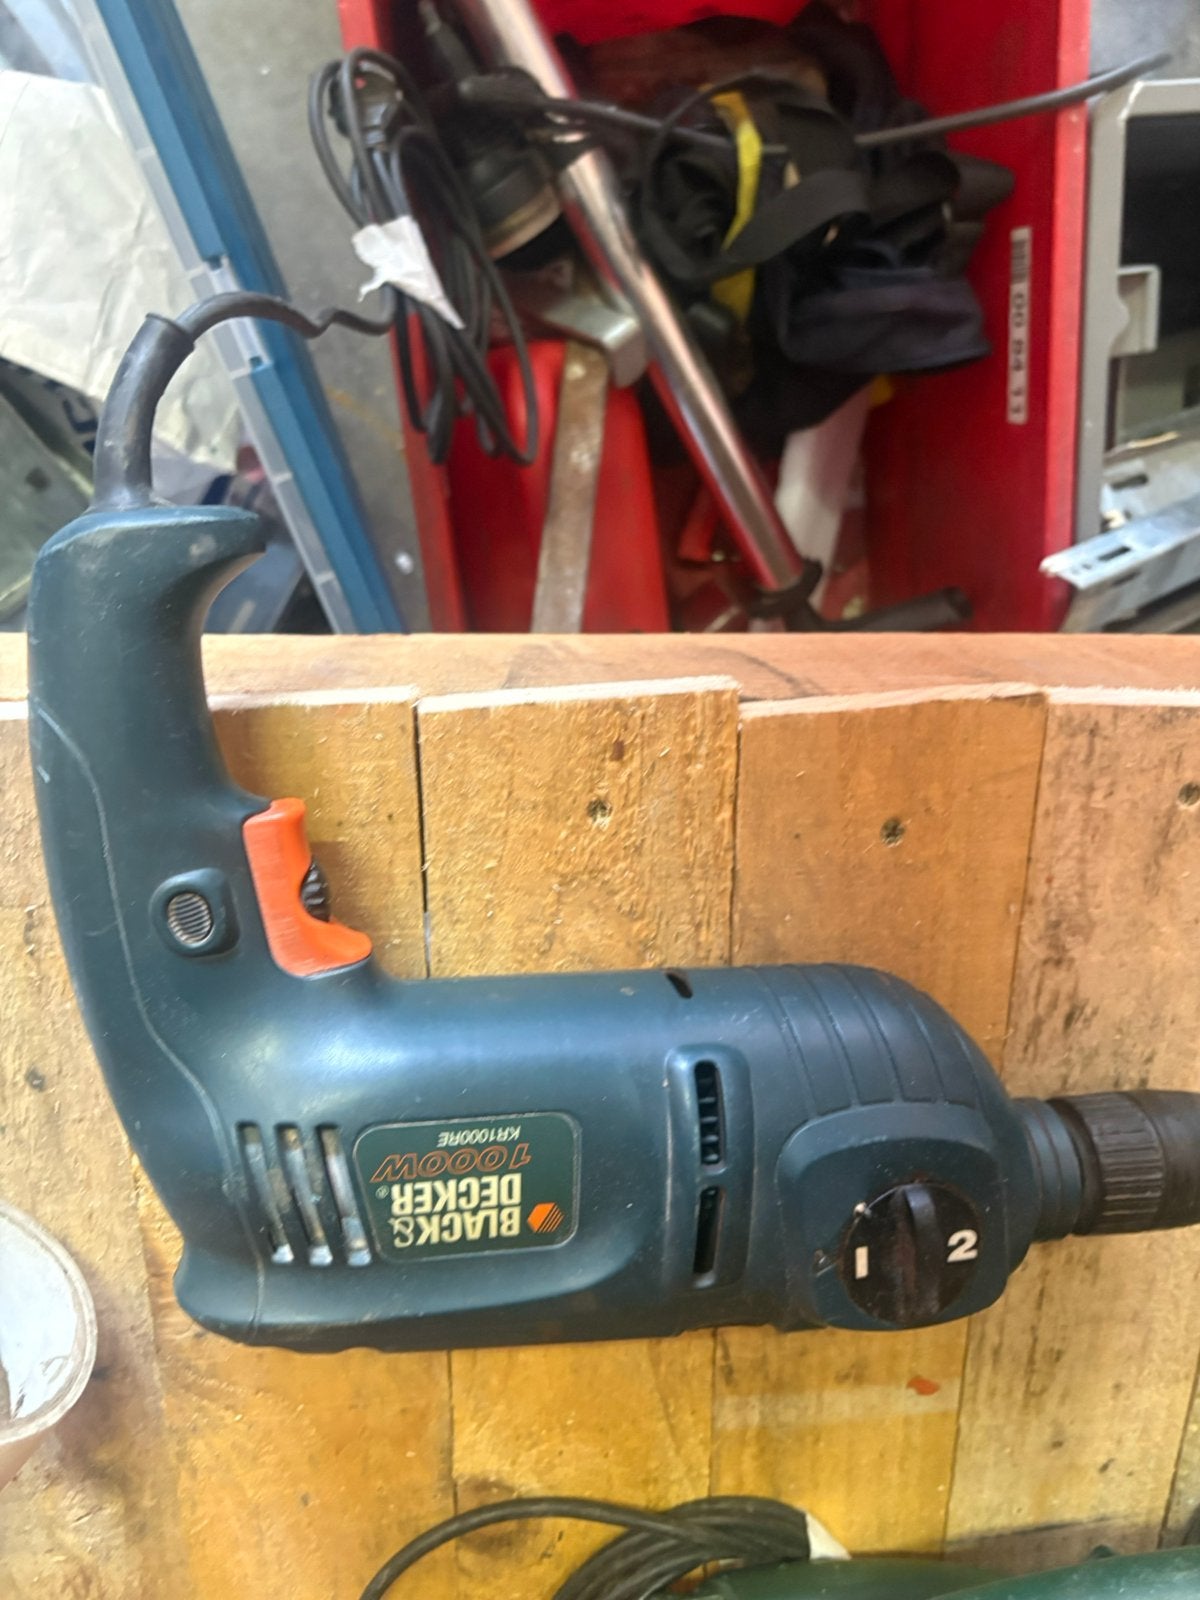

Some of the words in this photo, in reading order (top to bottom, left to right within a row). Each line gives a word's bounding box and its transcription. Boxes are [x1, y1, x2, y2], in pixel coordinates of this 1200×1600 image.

[436, 1125, 521, 1147] KR1000RE
[369, 1142, 532, 1182] 1000W
[947, 1229, 978, 1263] 2
